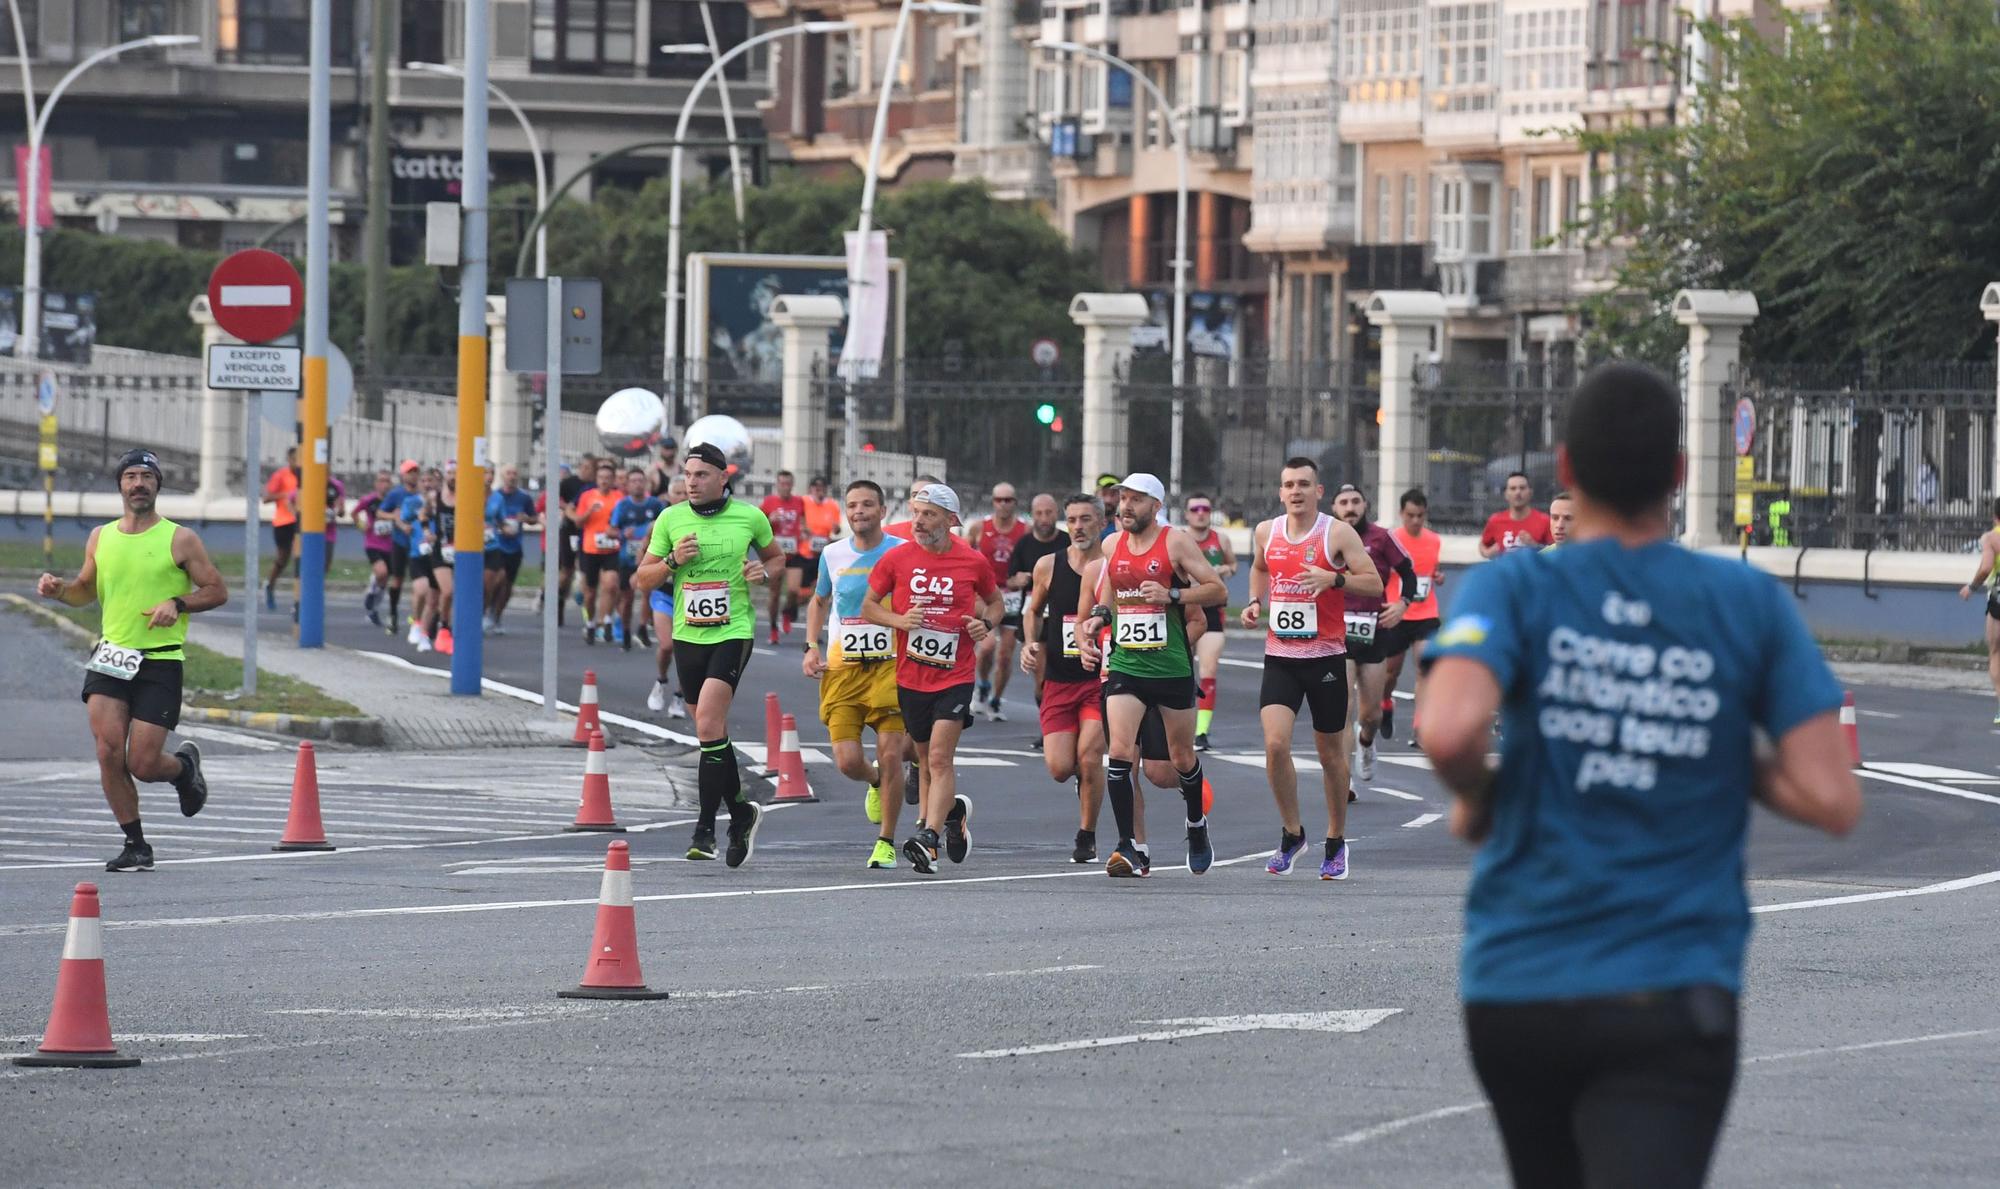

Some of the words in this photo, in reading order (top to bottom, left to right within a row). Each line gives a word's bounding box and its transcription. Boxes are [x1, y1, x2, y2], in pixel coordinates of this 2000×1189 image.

[230, 350, 281, 360] EXCEPTO
[216, 375, 294, 385] ARTICULADOS
[687, 597, 727, 617] 465
[1277, 611, 1305, 630] 68
[1347, 622, 1371, 636] 16
[844, 632, 887, 652] 216
[1066, 631, 1080, 649] 2
[1120, 622, 1163, 642] 251
[911, 635, 953, 660] 494
[1548, 627, 1657, 677] Corre
[1659, 646, 1715, 682] co
[99, 648, 138, 671] 306
[1538, 706, 1615, 746] aos
[1619, 715, 1711, 758] teus
